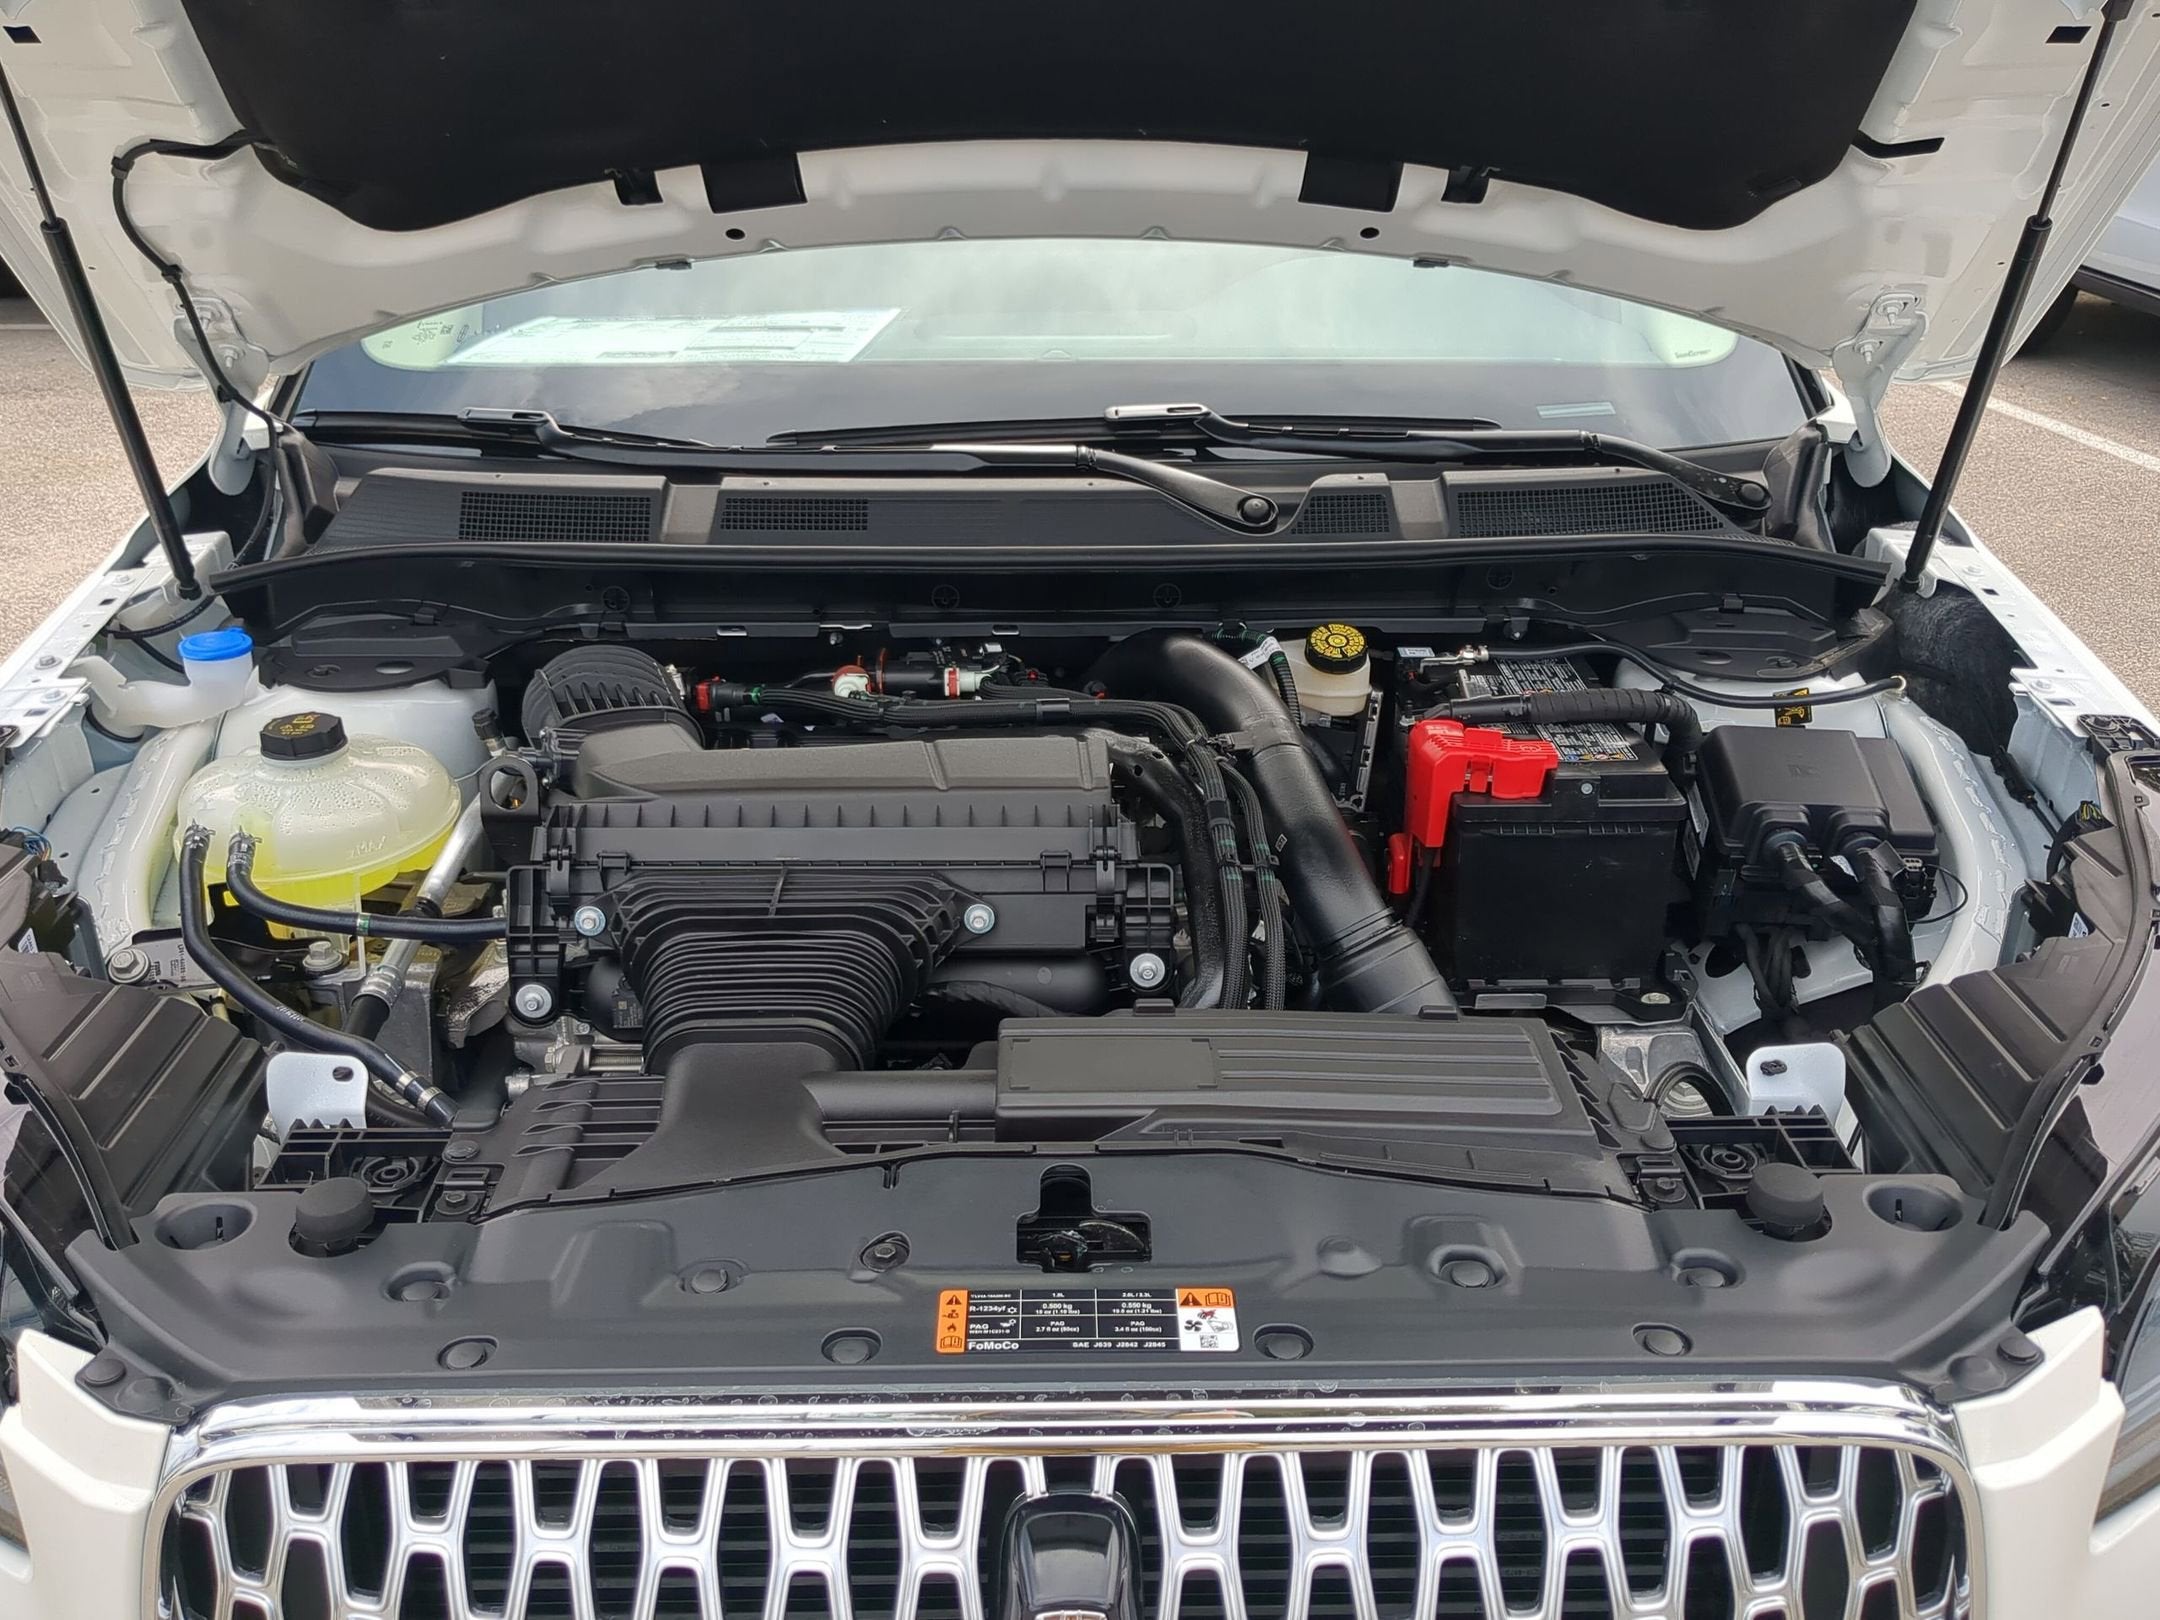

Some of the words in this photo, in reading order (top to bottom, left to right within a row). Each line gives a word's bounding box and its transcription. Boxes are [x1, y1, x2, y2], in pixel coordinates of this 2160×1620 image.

[969, 1305, 1006, 1313] R-1234yf
[1063, 1302, 1073, 1311] kg
[1142, 1301, 1152, 1309] kg
[968, 1341, 1020, 1350] FoMoCo
